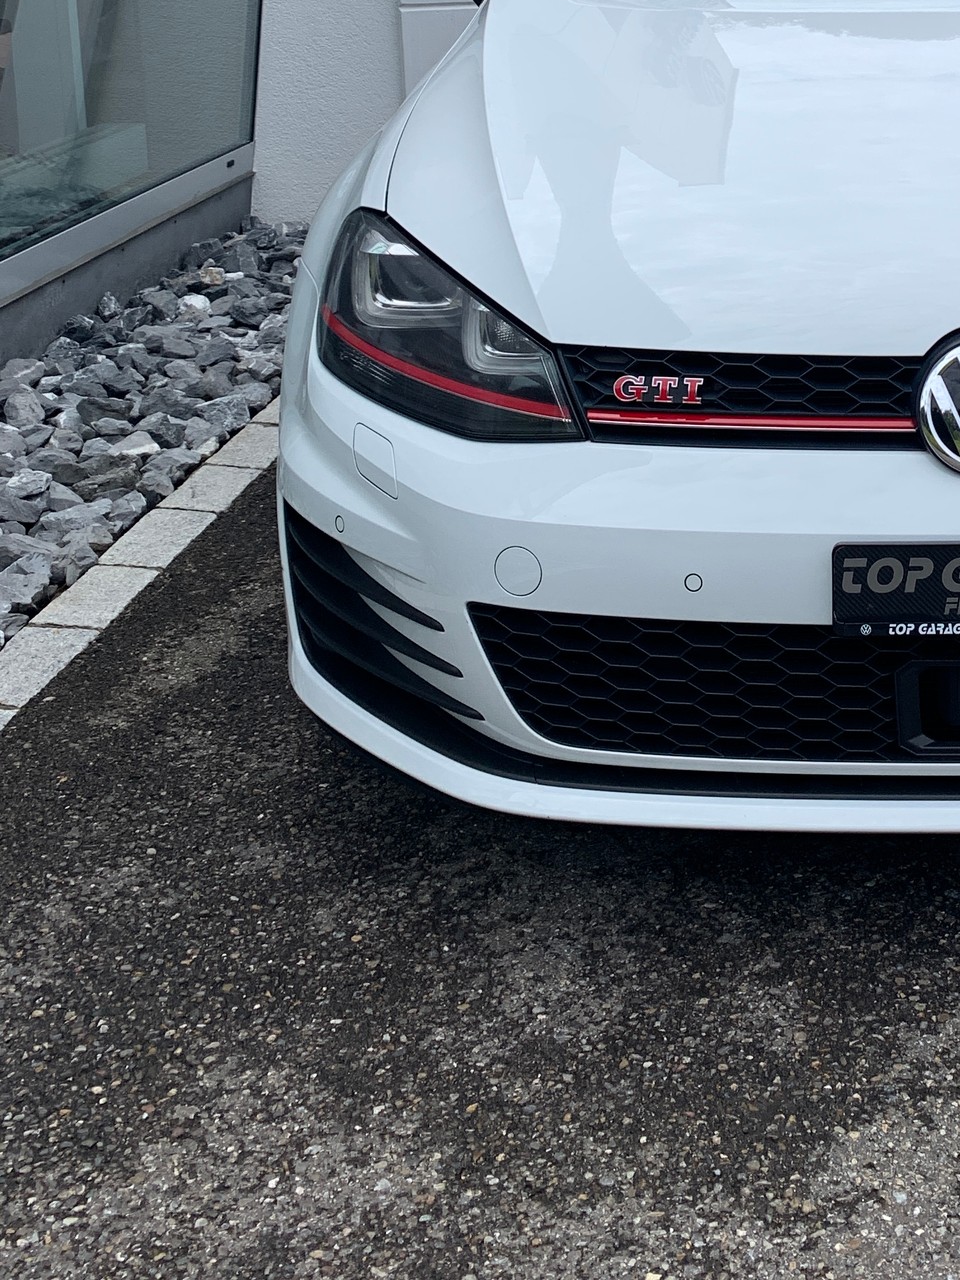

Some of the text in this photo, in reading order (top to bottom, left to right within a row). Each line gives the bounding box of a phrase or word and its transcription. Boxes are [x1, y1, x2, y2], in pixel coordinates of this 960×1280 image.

[612, 374, 704, 404] GTI
[841, 557, 934, 594] TOP
[888, 623, 915, 636] TOP
